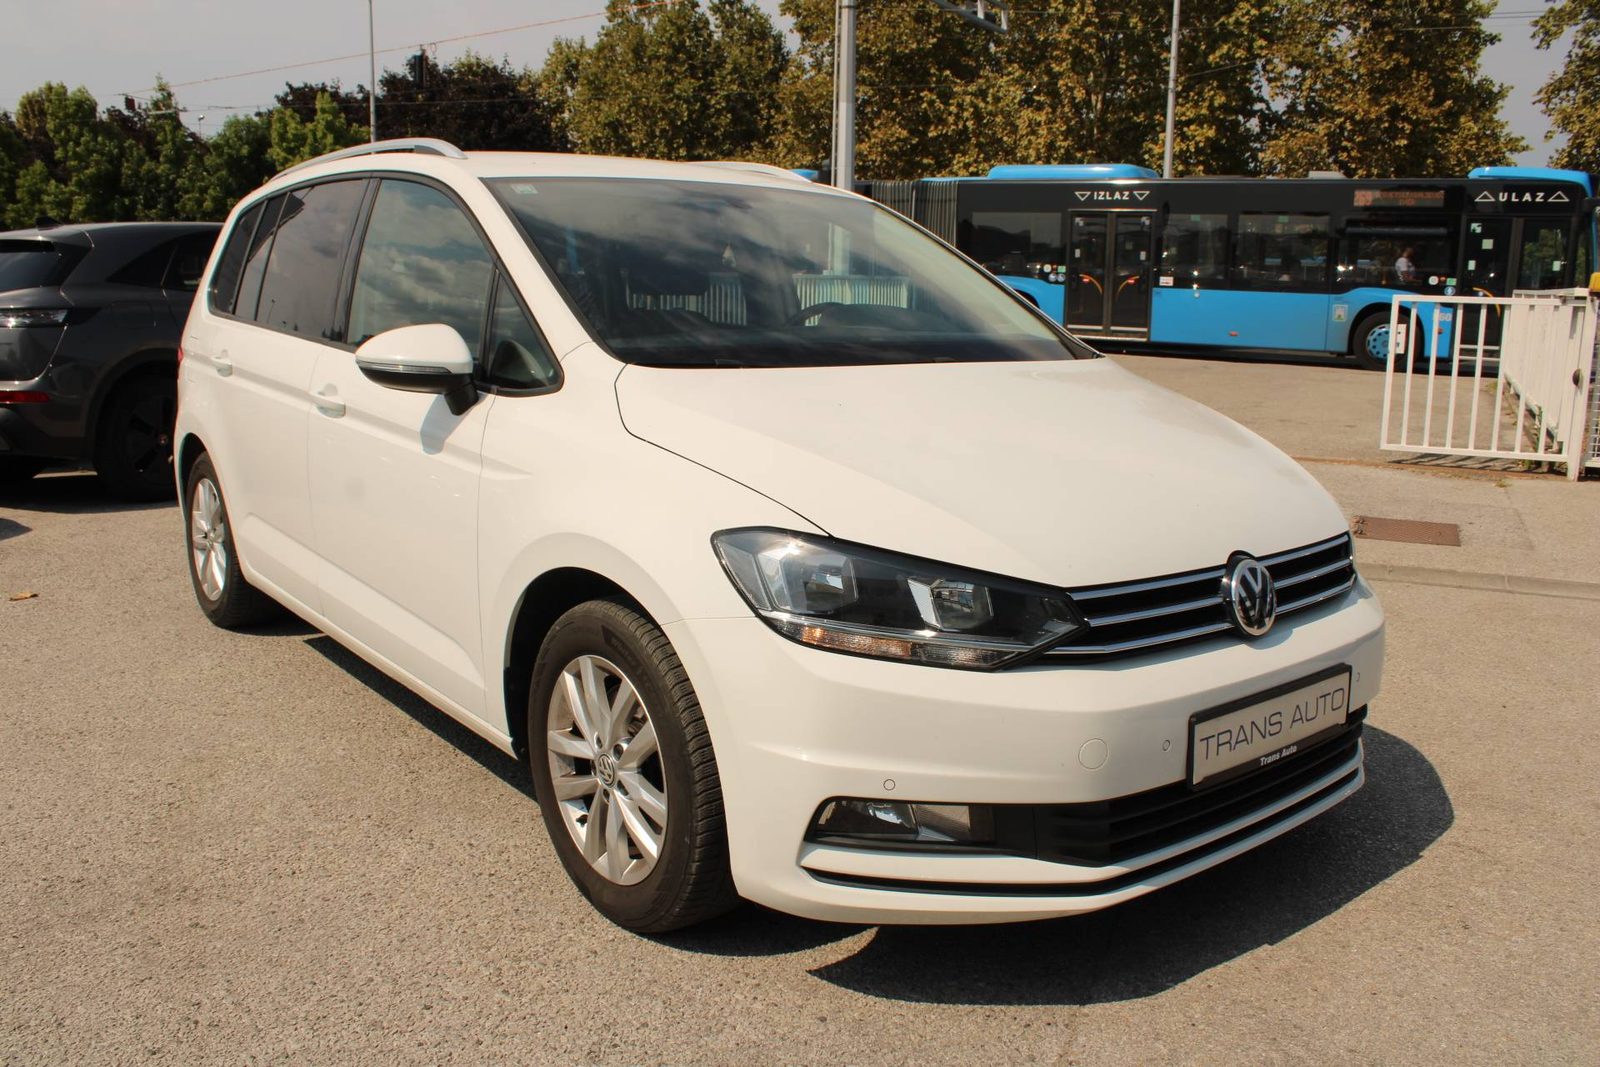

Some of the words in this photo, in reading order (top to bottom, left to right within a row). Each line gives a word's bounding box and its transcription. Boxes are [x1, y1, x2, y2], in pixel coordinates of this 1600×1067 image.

[1093, 191, 1130, 200] IZLAZ
[1498, 192, 1545, 202] ULAZ
[1199, 711, 1283, 760] TRANS
[1289, 687, 1345, 729] AUTO
[1259, 752, 1281, 767] Trans
[1280, 744, 1298, 758] Auto
